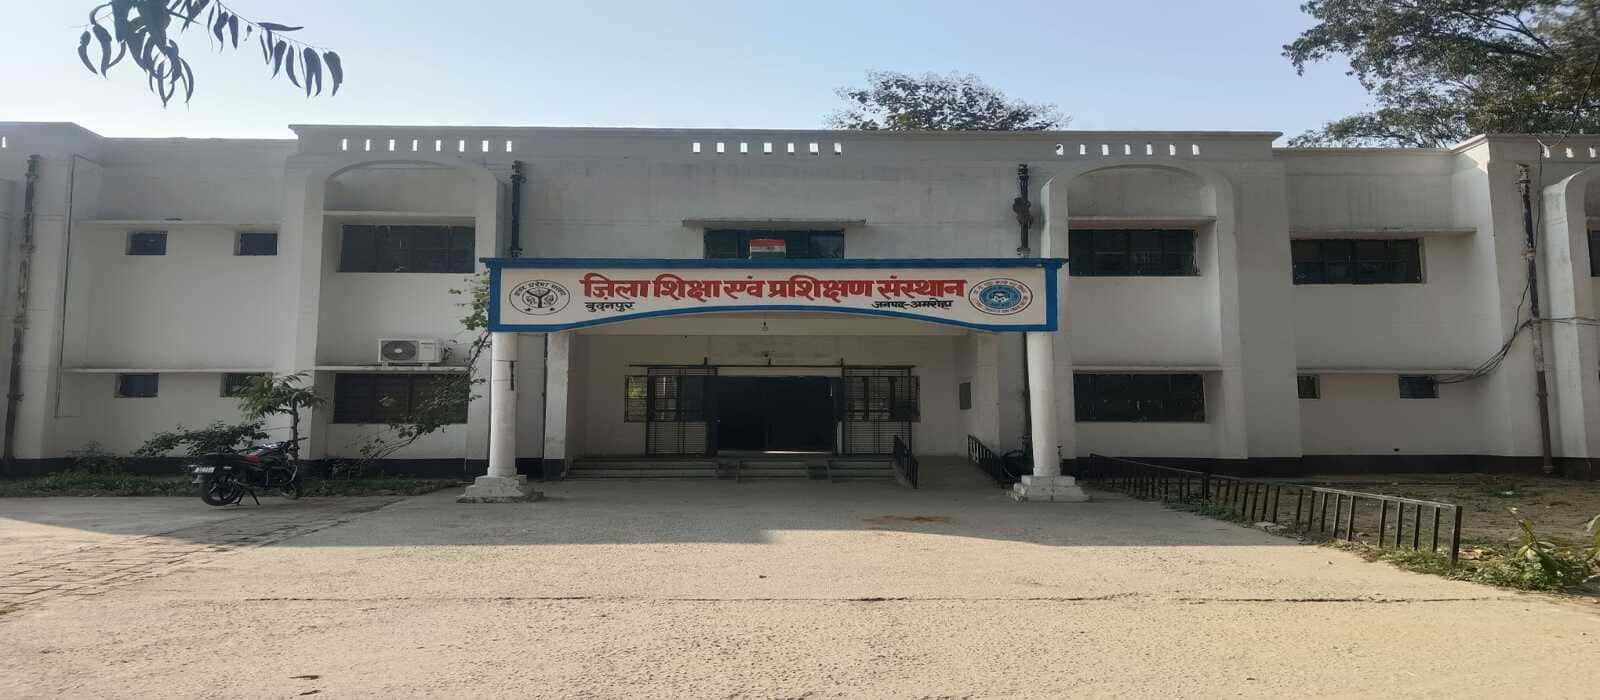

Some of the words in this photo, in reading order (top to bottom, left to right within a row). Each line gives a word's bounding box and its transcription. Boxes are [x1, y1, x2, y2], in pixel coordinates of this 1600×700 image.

[652, 273, 722, 302] शिक्षा
[723, 275, 765, 299] एवं
[766, 275, 874, 302] प्रशिक्षण
[876, 275, 967, 300] संस्थान
